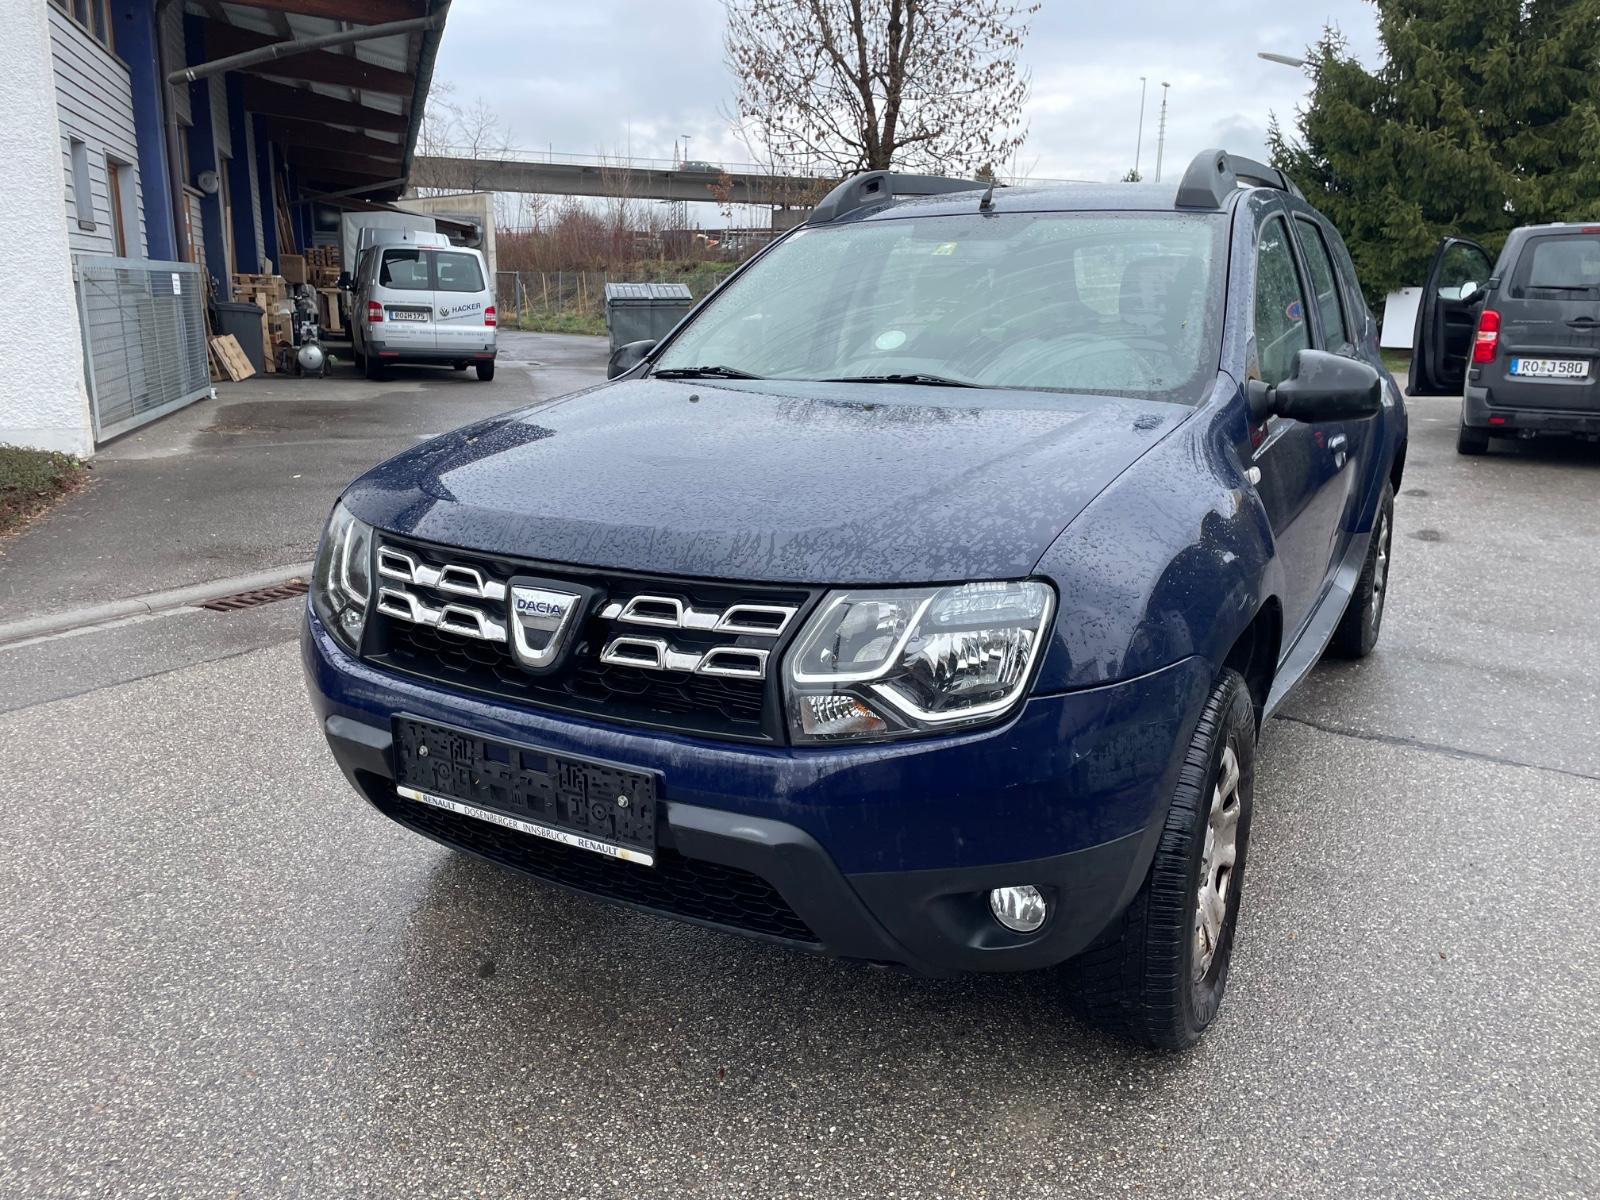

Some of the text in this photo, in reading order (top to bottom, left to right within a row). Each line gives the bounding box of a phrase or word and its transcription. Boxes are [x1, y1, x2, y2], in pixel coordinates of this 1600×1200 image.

[452, 302, 481, 313] HACKER
[1522, 361, 1539, 372] RO
[1559, 362, 1582, 373] 580
[517, 598, 561, 616] DACIA
[422, 794, 618, 856] RENAULT DOSENBERGER INNSBRUCK RENAULT
